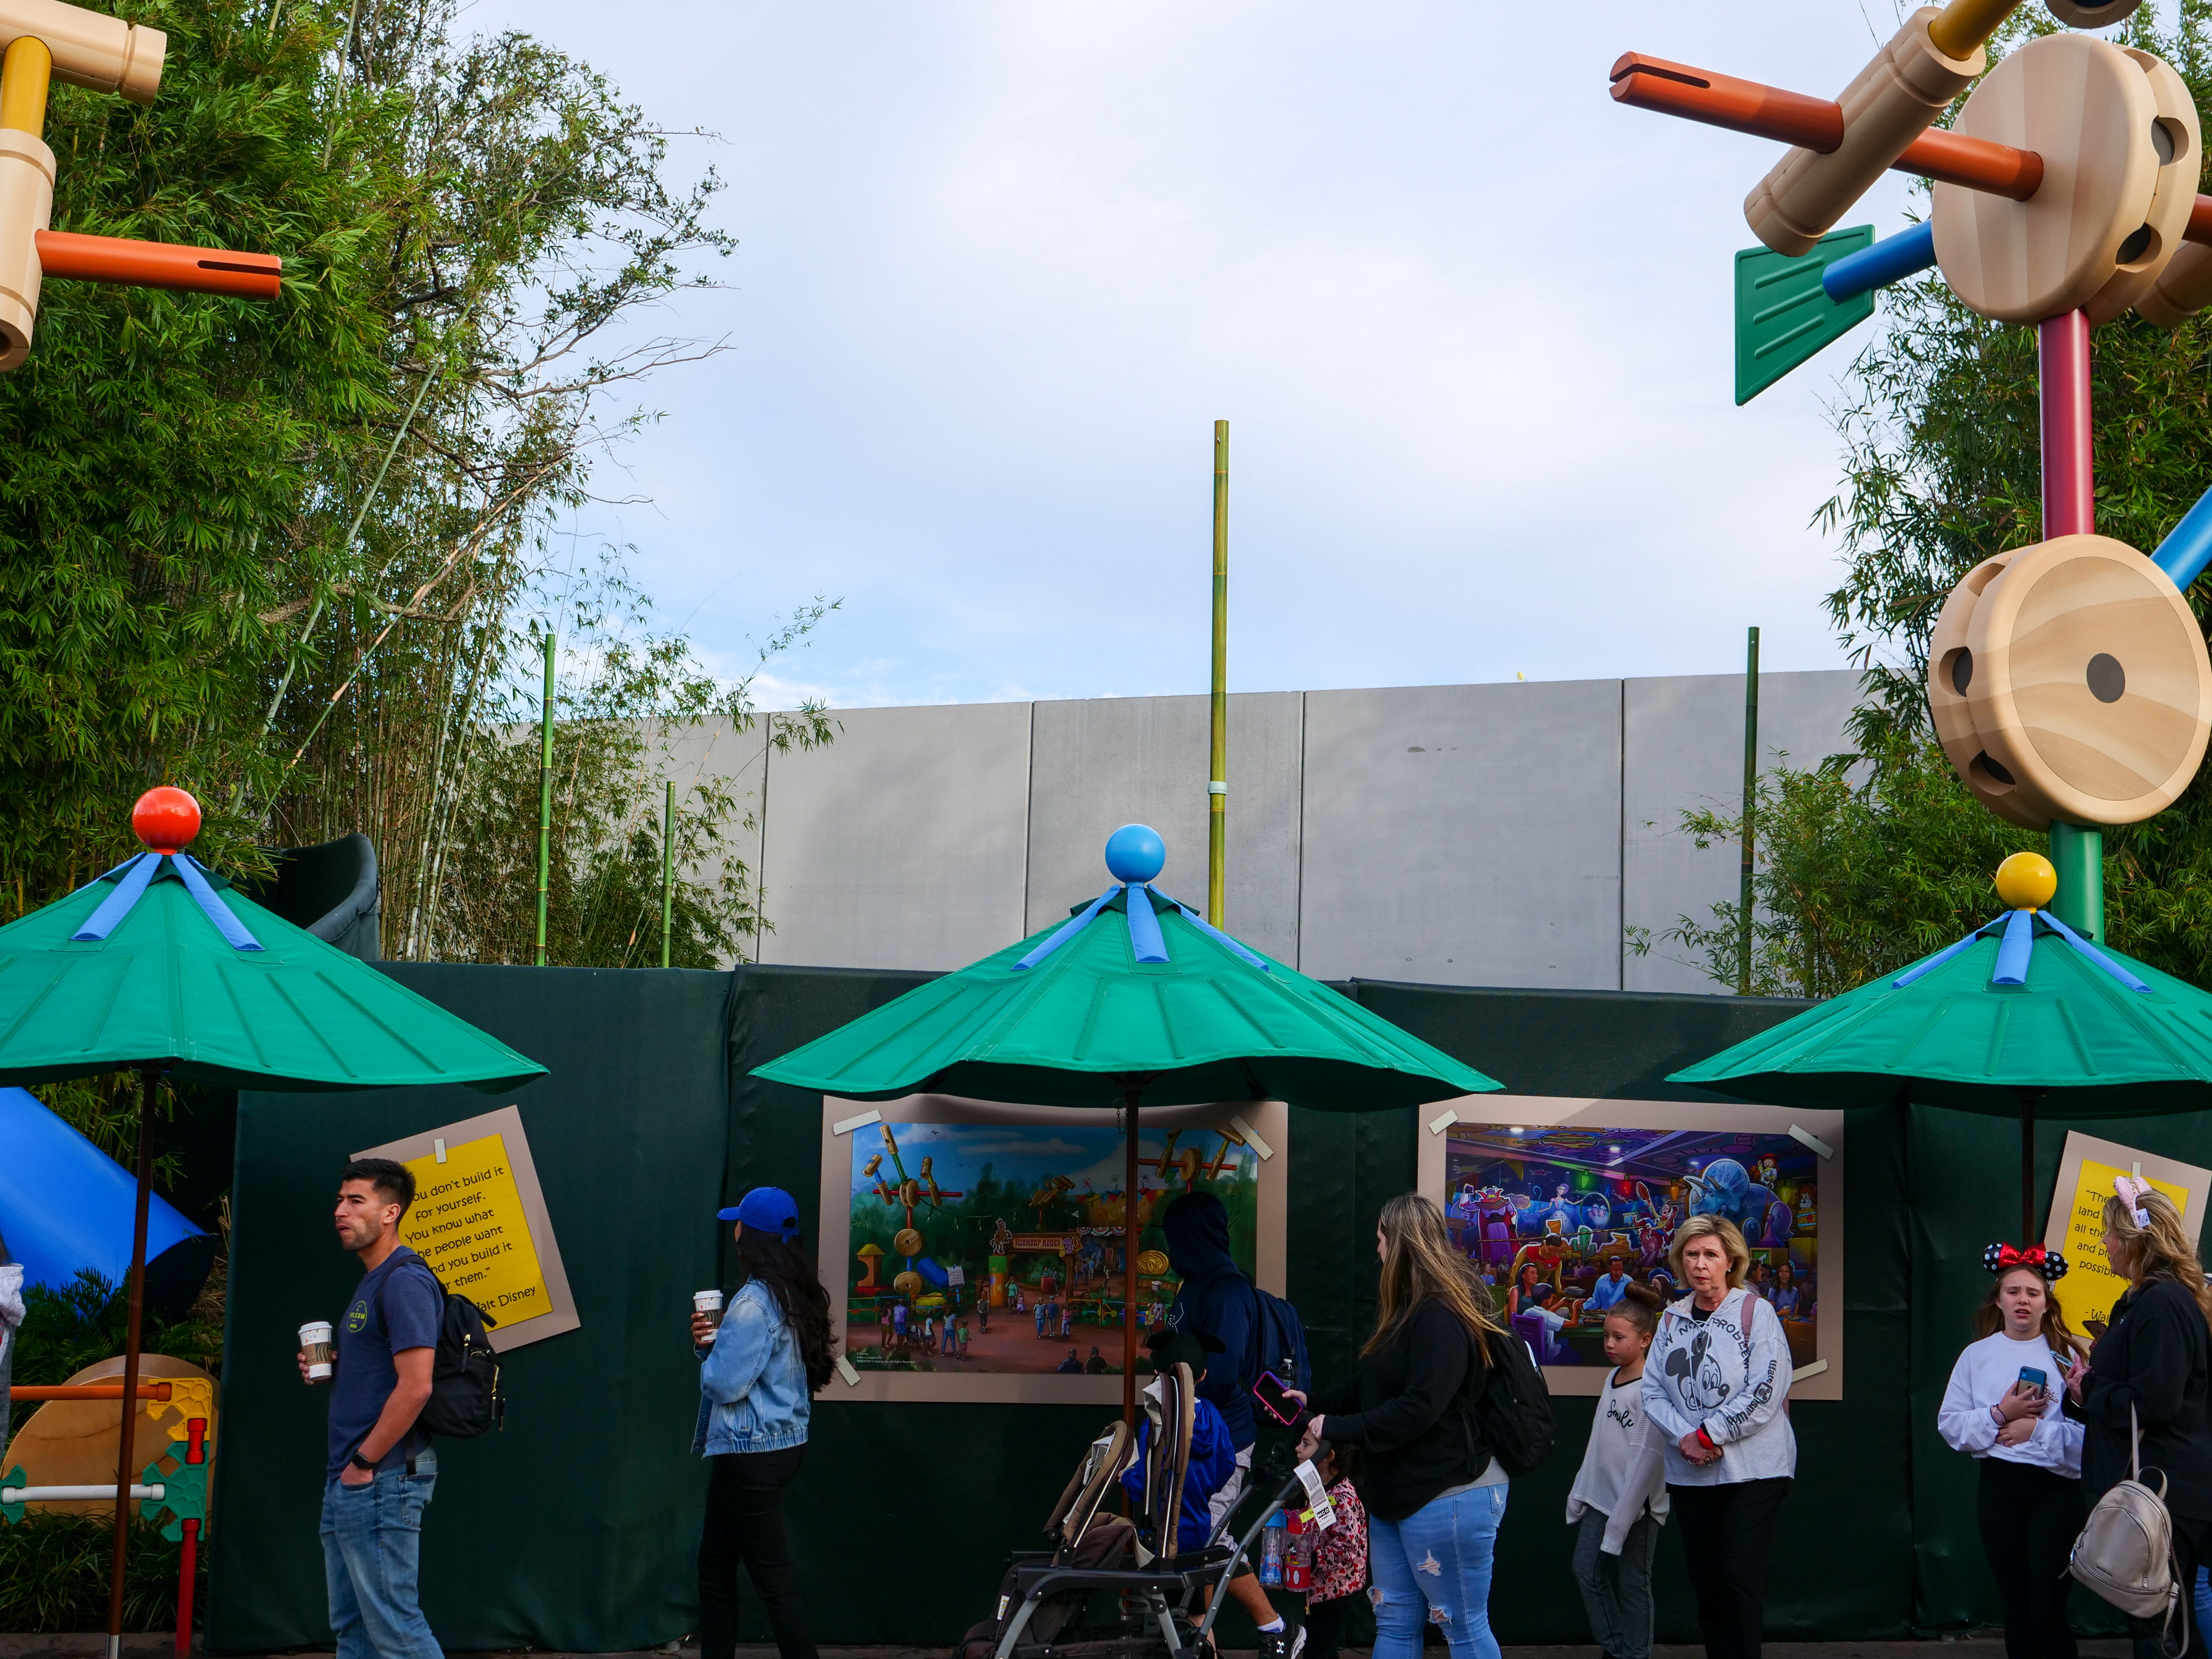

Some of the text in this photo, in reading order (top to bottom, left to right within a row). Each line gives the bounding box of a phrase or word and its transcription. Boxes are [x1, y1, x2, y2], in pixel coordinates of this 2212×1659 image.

[412, 1167, 504, 1201] ou don’t build it
[415, 1192, 486, 1222] for yourself.
[2079, 1206, 2100, 1219] land
[405, 1208, 495, 1244] You know what
[2074, 1223, 2086, 1234] all
[417, 1226, 504, 1259] he people want
[1042, 1239, 1061, 1247] RODEO
[1058, 1237, 1083, 1257] BBQ
[2077, 1242, 2096, 1254] and
[430, 1242, 512, 1274] nd you build it
[453, 1267, 490, 1287] them.”
[2079, 1261, 2116, 1278] possib
[498, 1286, 536, 1307] Disney
[2092, 1309, 2109, 1323] Wal
[1607, 1399, 1634, 1428] Smile
[1317, 1508, 1329, 1518] MCO
